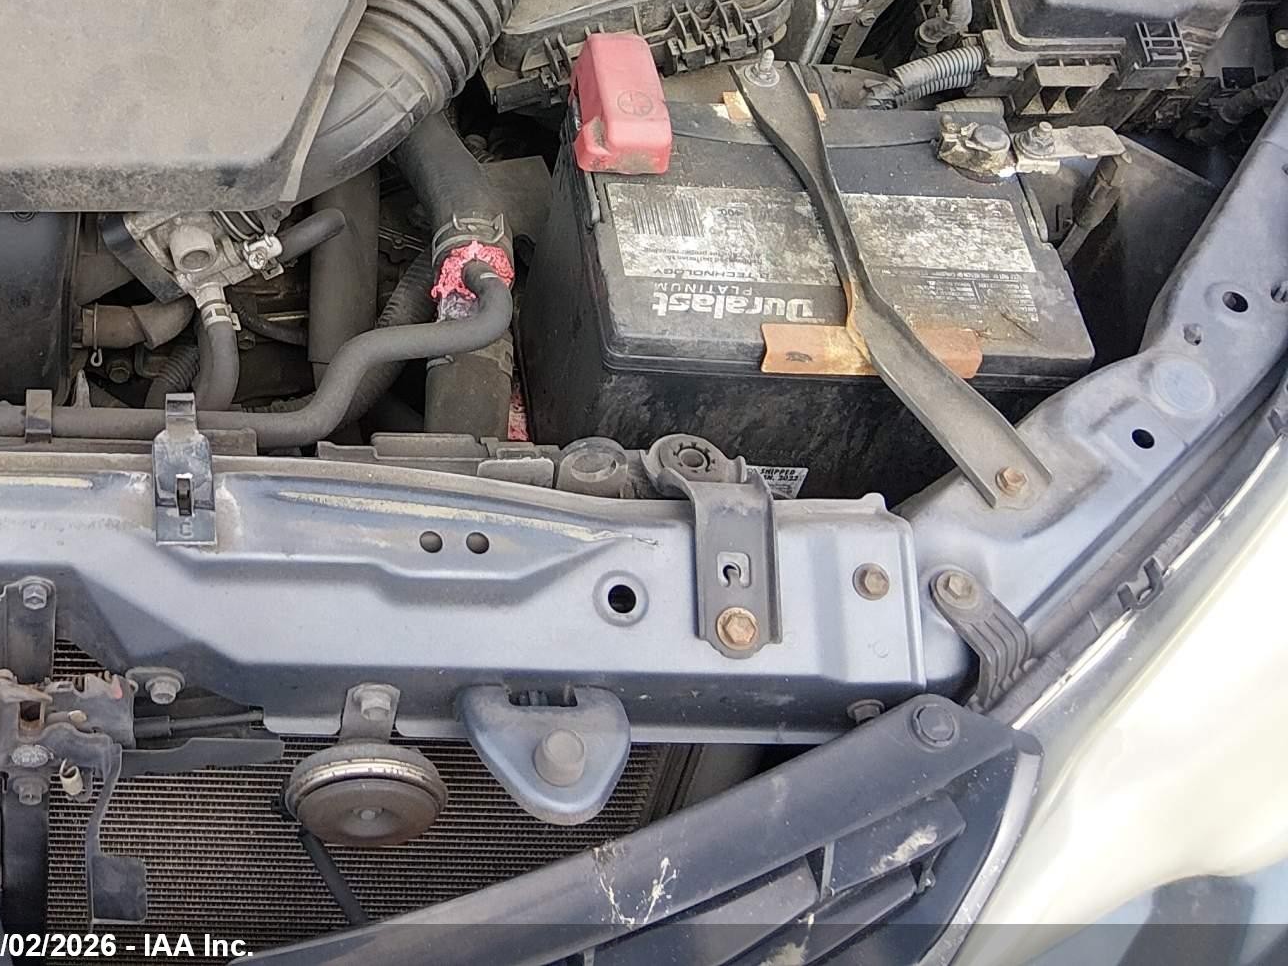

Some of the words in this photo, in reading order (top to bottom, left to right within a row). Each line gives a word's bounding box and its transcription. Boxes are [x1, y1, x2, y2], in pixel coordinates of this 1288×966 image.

[653, 267, 754, 279] TECHNOLOGY
[654, 282, 753, 296] PLATINUM
[652, 291, 825, 324] Duralast
